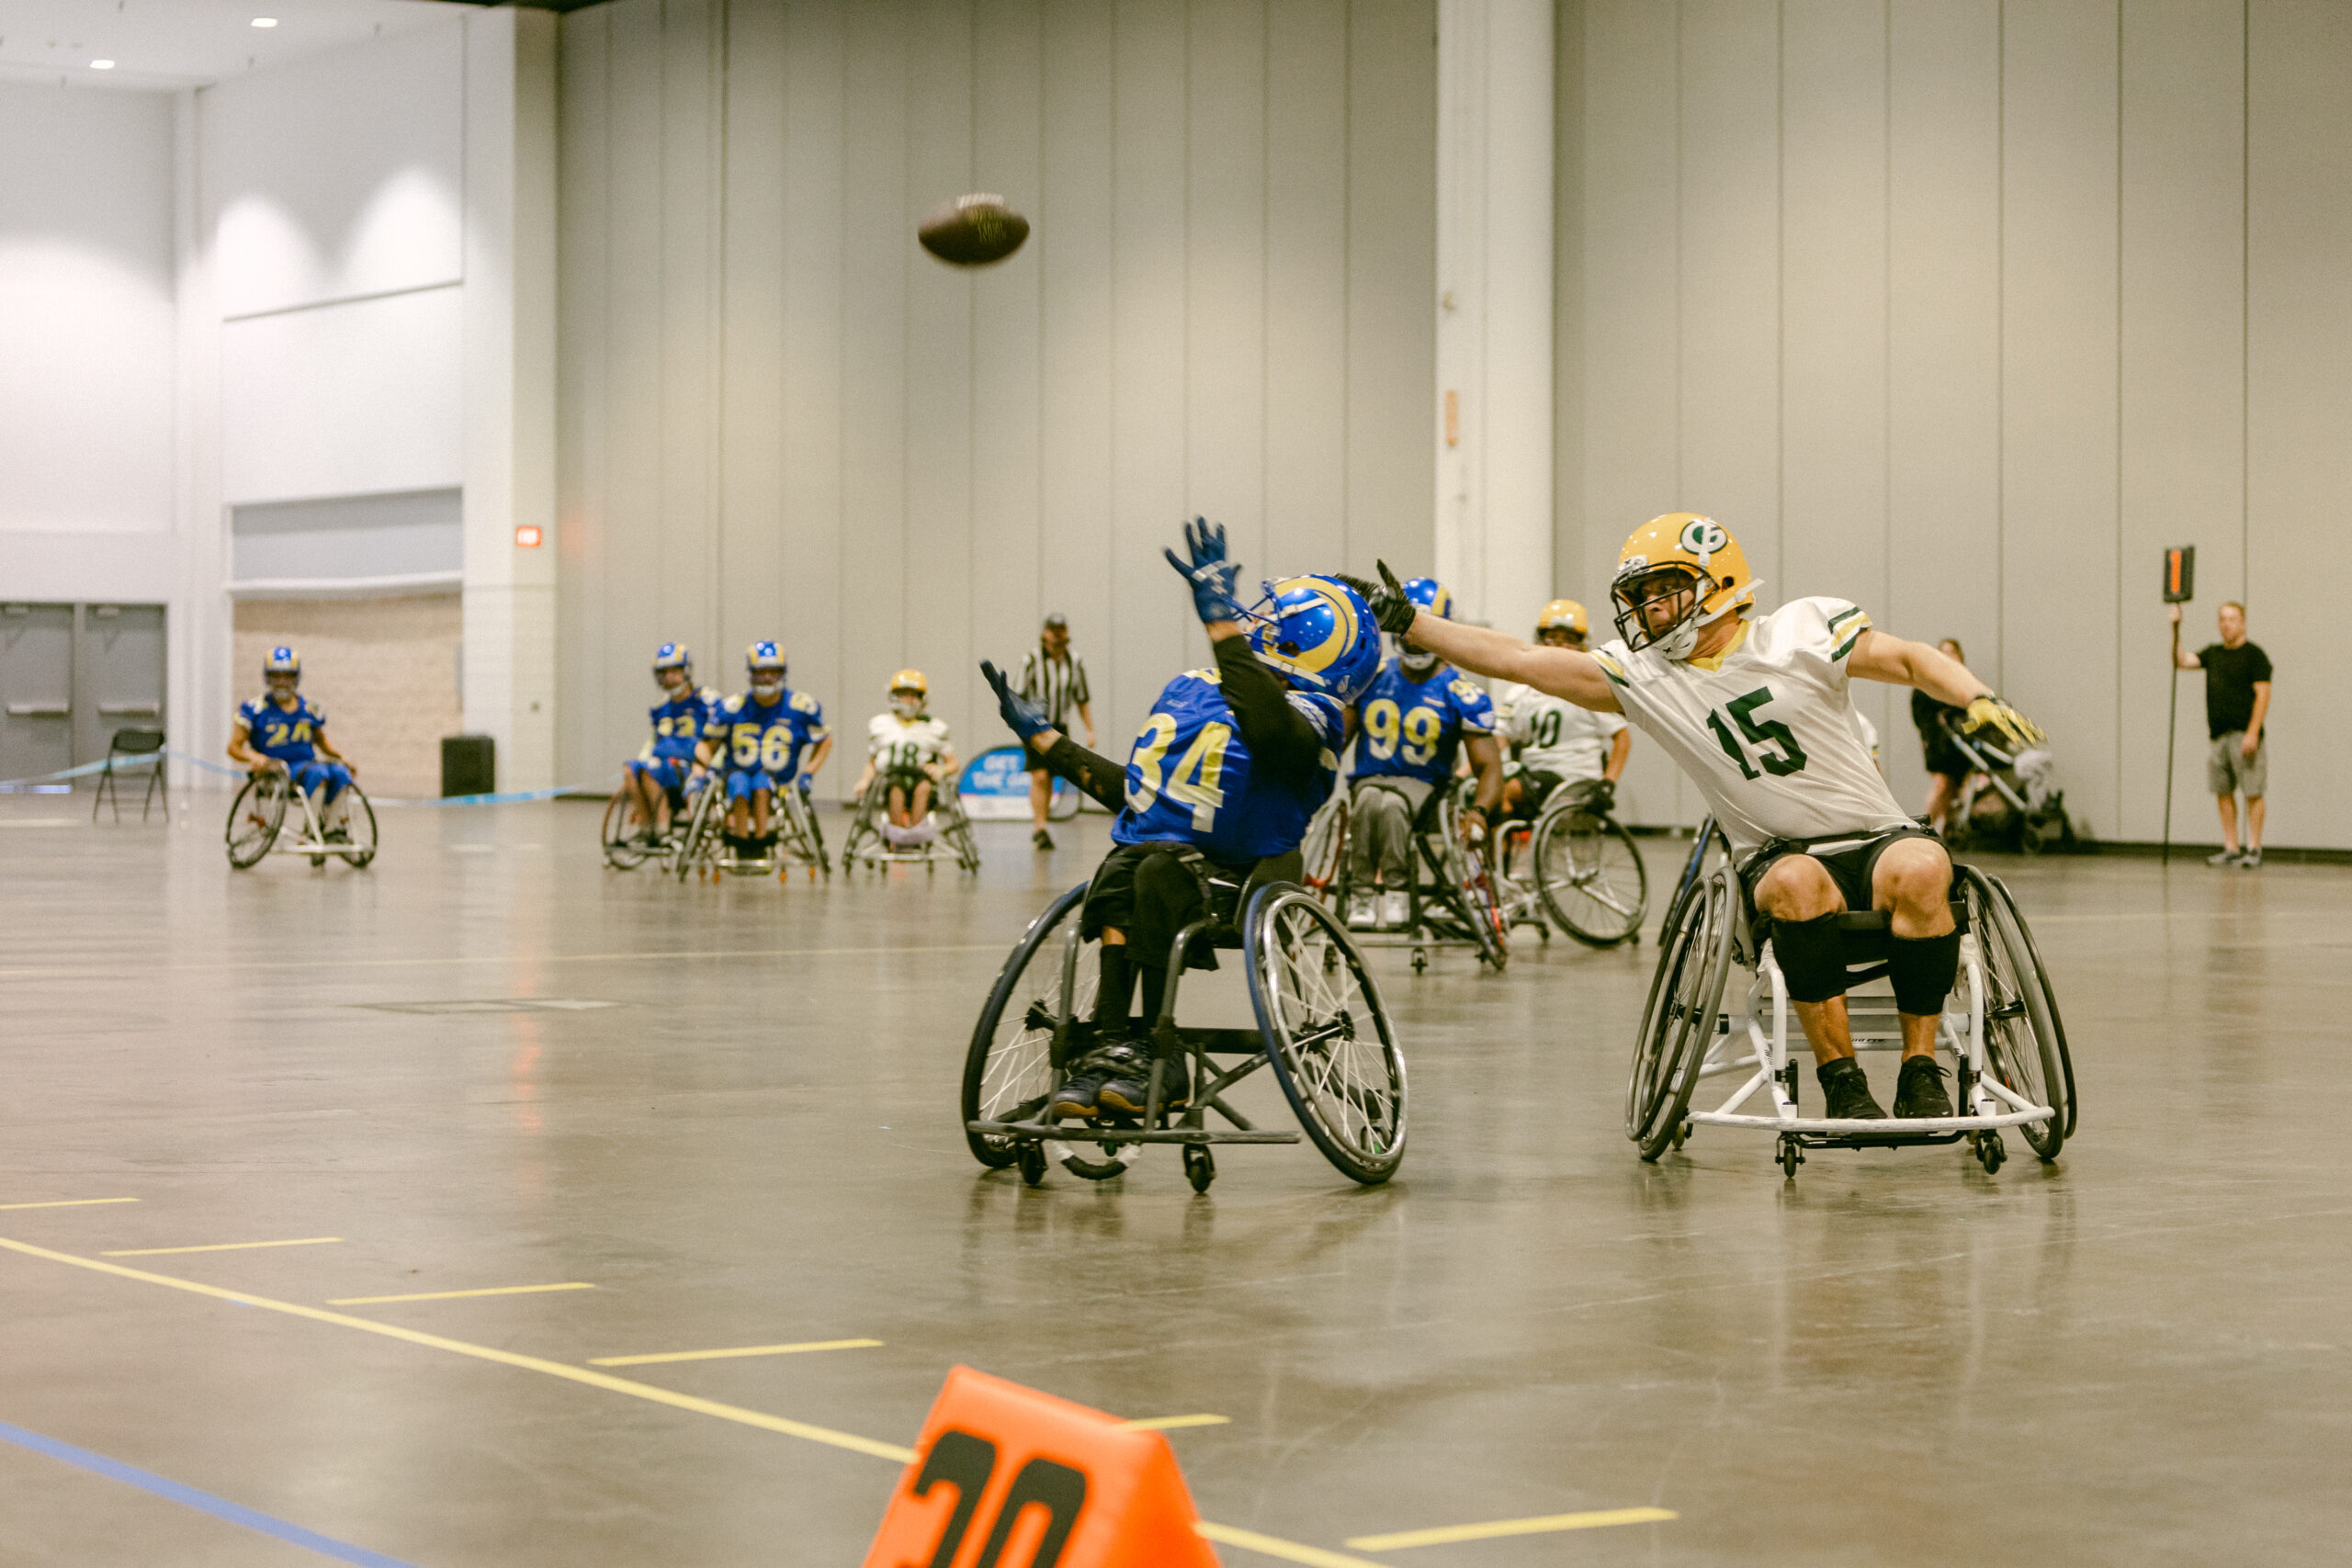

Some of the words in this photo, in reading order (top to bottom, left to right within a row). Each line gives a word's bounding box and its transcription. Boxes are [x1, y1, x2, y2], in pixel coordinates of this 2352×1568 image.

[731, 722, 794, 772] 56
[1124, 712, 1232, 833] 34
[1363, 697, 1442, 766] 99
[1706, 685, 1808, 781] 15
